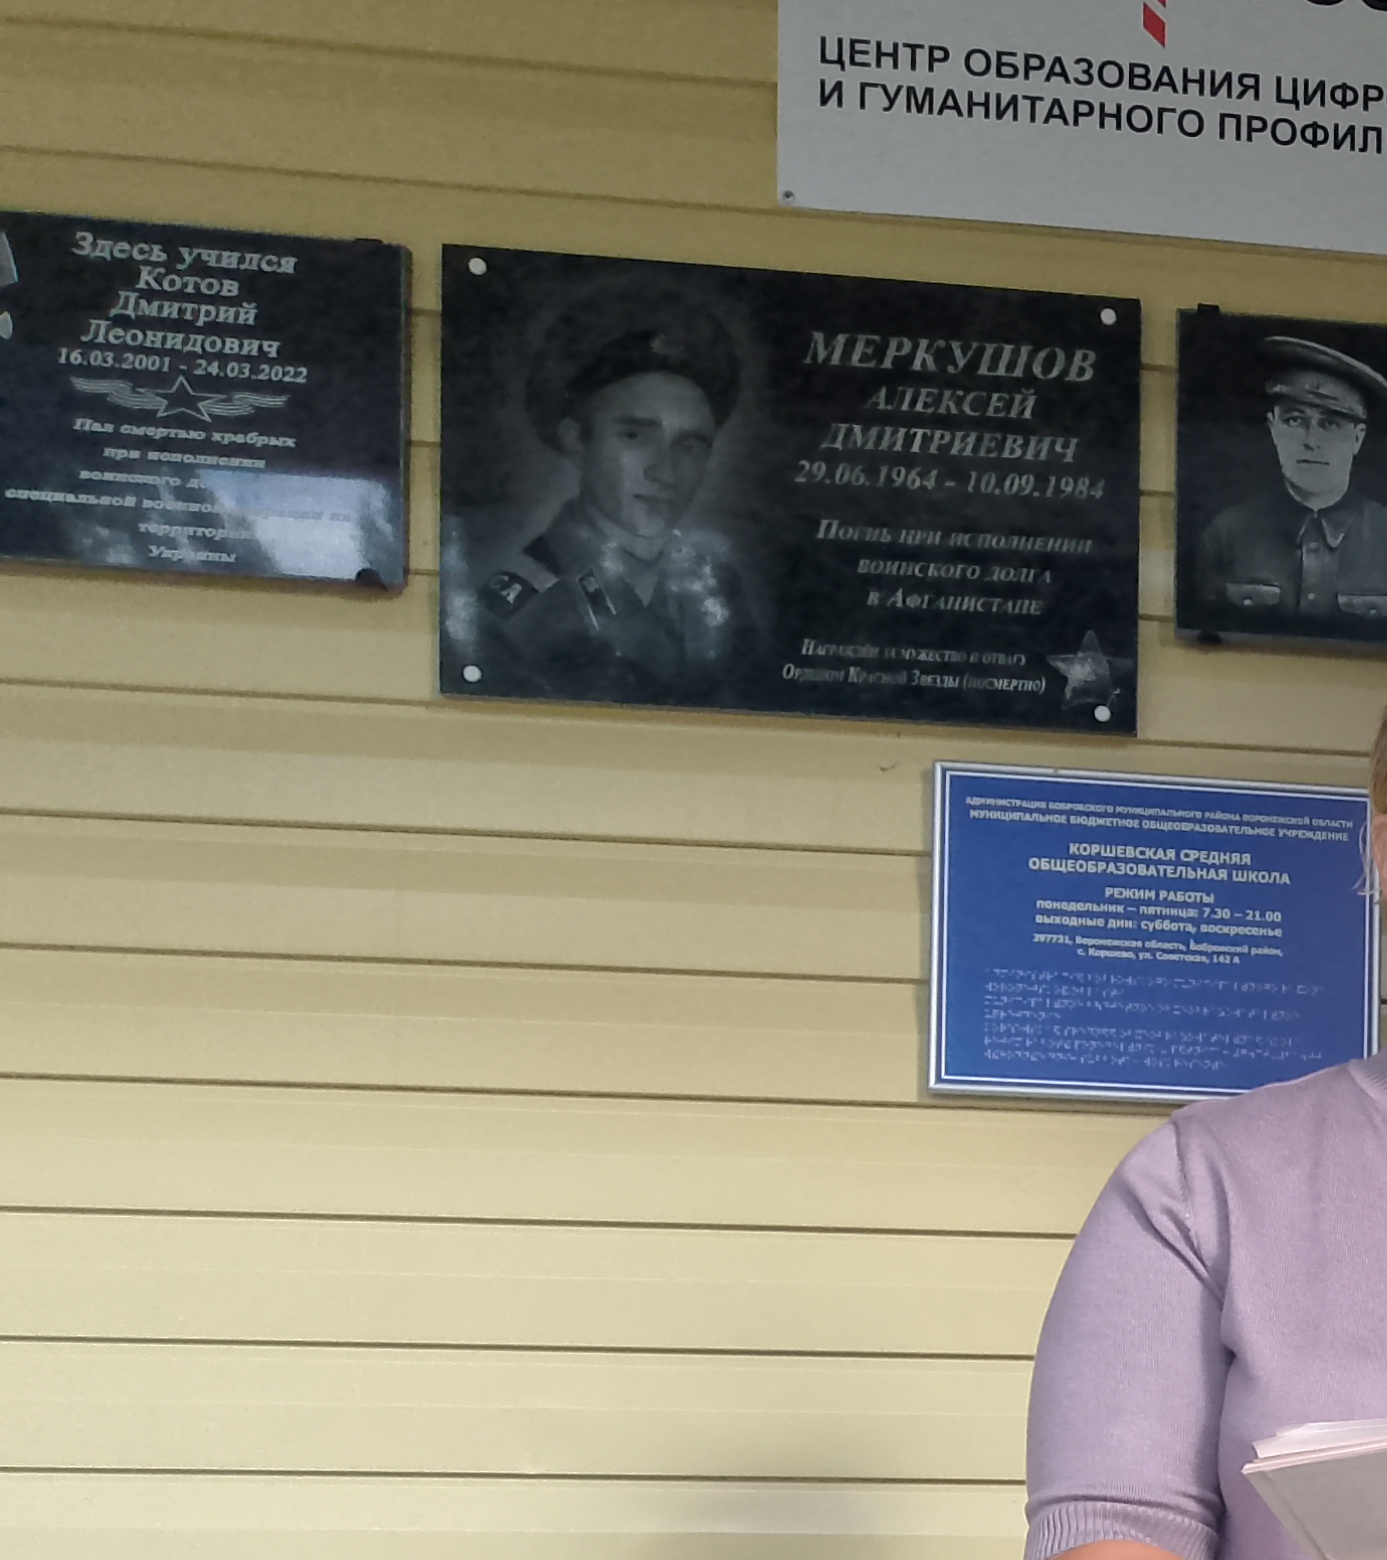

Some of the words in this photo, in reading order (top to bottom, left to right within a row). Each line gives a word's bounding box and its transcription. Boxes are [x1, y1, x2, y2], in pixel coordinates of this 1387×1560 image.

[819, 35, 951, 74] ЦЕНТР
[963, 48, 1261, 103] ОБРАЗОВАНИЯ
[819, 78, 846, 108] И
[858, 82, 1205, 139] ГУМАНИТАРНОГО
[71, 231, 168, 262] Здесь
[177, 246, 298, 275] учился
[135, 265, 240, 298] Котов
[109, 291, 258, 327] Дмитрий
[80, 319, 281, 359] Леонидович
[57, 347, 171, 373] 16.03.2001
[192, 358, 308, 384] 24.03.2022
[803, 331, 1098, 382] МЕРКУШОВ
[865, 386, 1038, 420] АЛЕКСЕЙ
[120, 423, 206, 442] смертью
[211, 430, 296, 449] храбрых
[819, 424, 1080, 463] ДМИТРИЕВИЧ
[794, 460, 937, 492] 29.06.1964
[967, 470, 1105, 500] 10.09.1984
[970, 809, 1068, 825] МУНИЦИПАЛЬНОЕ
[1069, 814, 1140, 829] БЮДЖЕТНОЕ
[1141, 817, 1276, 837] ОБЩЕОБРАЗОВАТЕЛЬНОЕ
[1278, 828, 1349, 842] УЧРЕЖДЕНИЕ
[1312, 818, 1353, 829] ОБЛАСТИ
[1069, 842, 1176, 861] КОРШЕВСКАЯ
[1180, 849, 1251, 866] СРЕДНЯЯ
[1028, 857, 1228, 881] ОБЩЕОБРАЗОВАТЕЛЬНАЯ
[1232, 870, 1291, 885] ШКОЛА
[1036, 900, 1125, 914] понедельник
[1139, 905, 1198, 919] пятница:
[1202, 907, 1231, 919] 7.30
[1245, 909, 1282, 922] 21.00
[1105, 886, 1155, 901] РЕЖИМ
[1159, 889, 1214, 904] РАБОТЫ
[1035, 914, 1104, 928] выходные
[1107, 918, 1137, 930] дни:
[1141, 919, 1198, 935] суббота,
[1200, 924, 1283, 937] воскресенье
[1075, 935, 1142, 948] Воронежская
[1250, 946, 1284, 957] район,
[1088, 948, 1137, 960] Коршево,
[1156, 952, 1210, 964] Советская,
